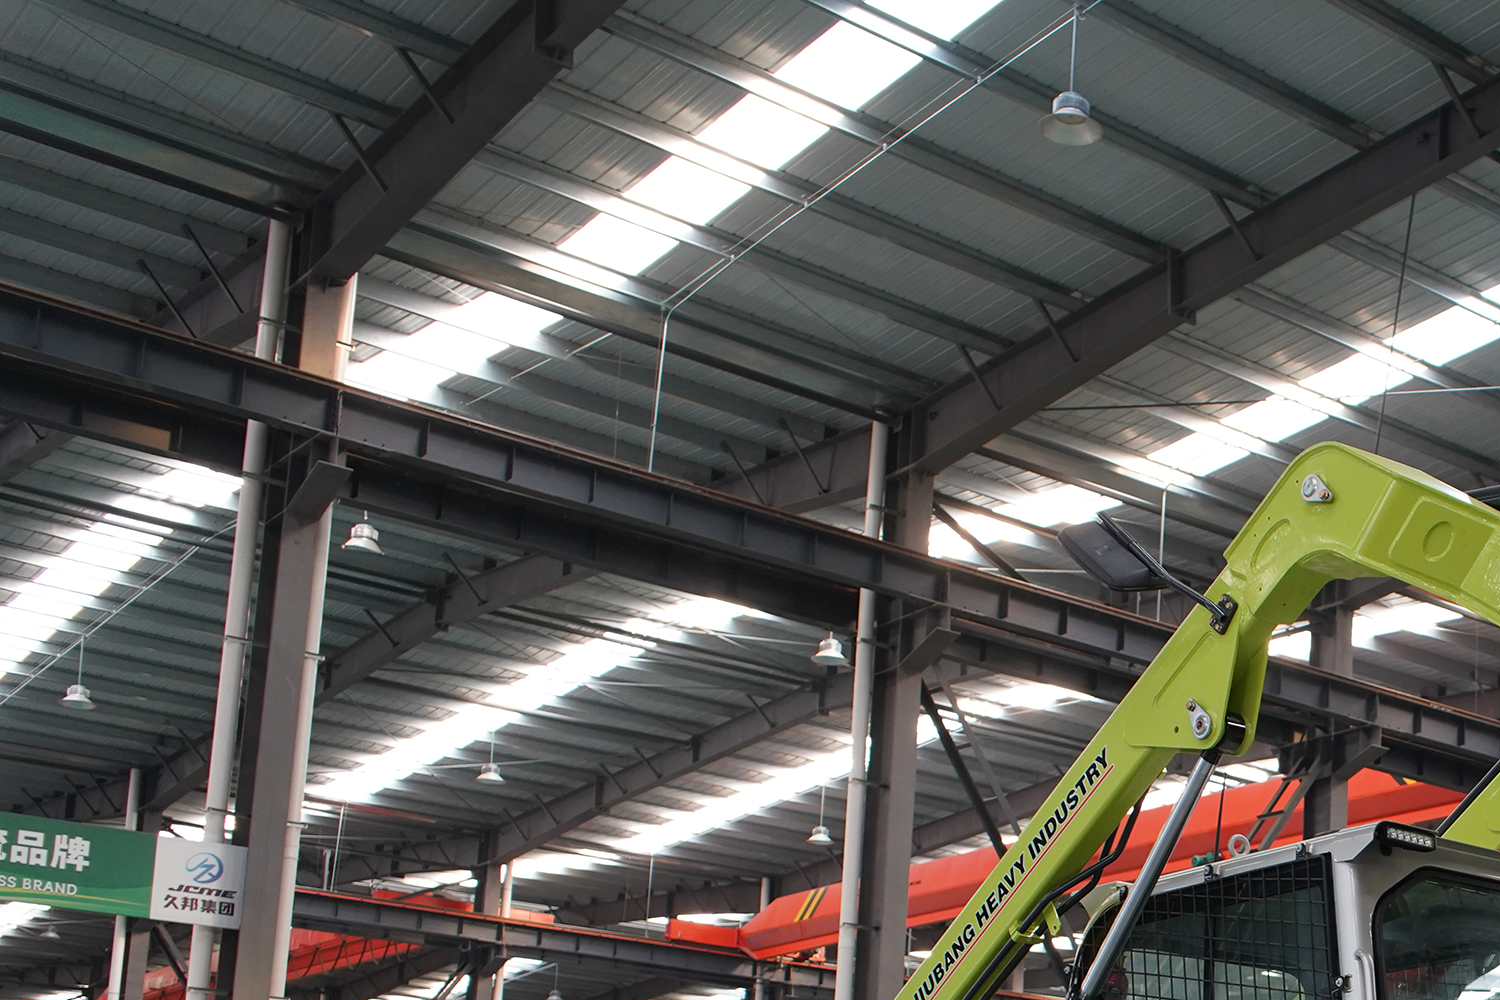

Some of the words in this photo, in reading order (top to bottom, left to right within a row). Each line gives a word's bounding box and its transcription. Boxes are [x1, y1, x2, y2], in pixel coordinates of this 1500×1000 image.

[974, 854, 1027, 928] HEAVY
[1027, 746, 1110, 861] INDUSTRY
[22, 878, 78, 895] BRAND
[163, 894, 235, 916] 久邦集团
